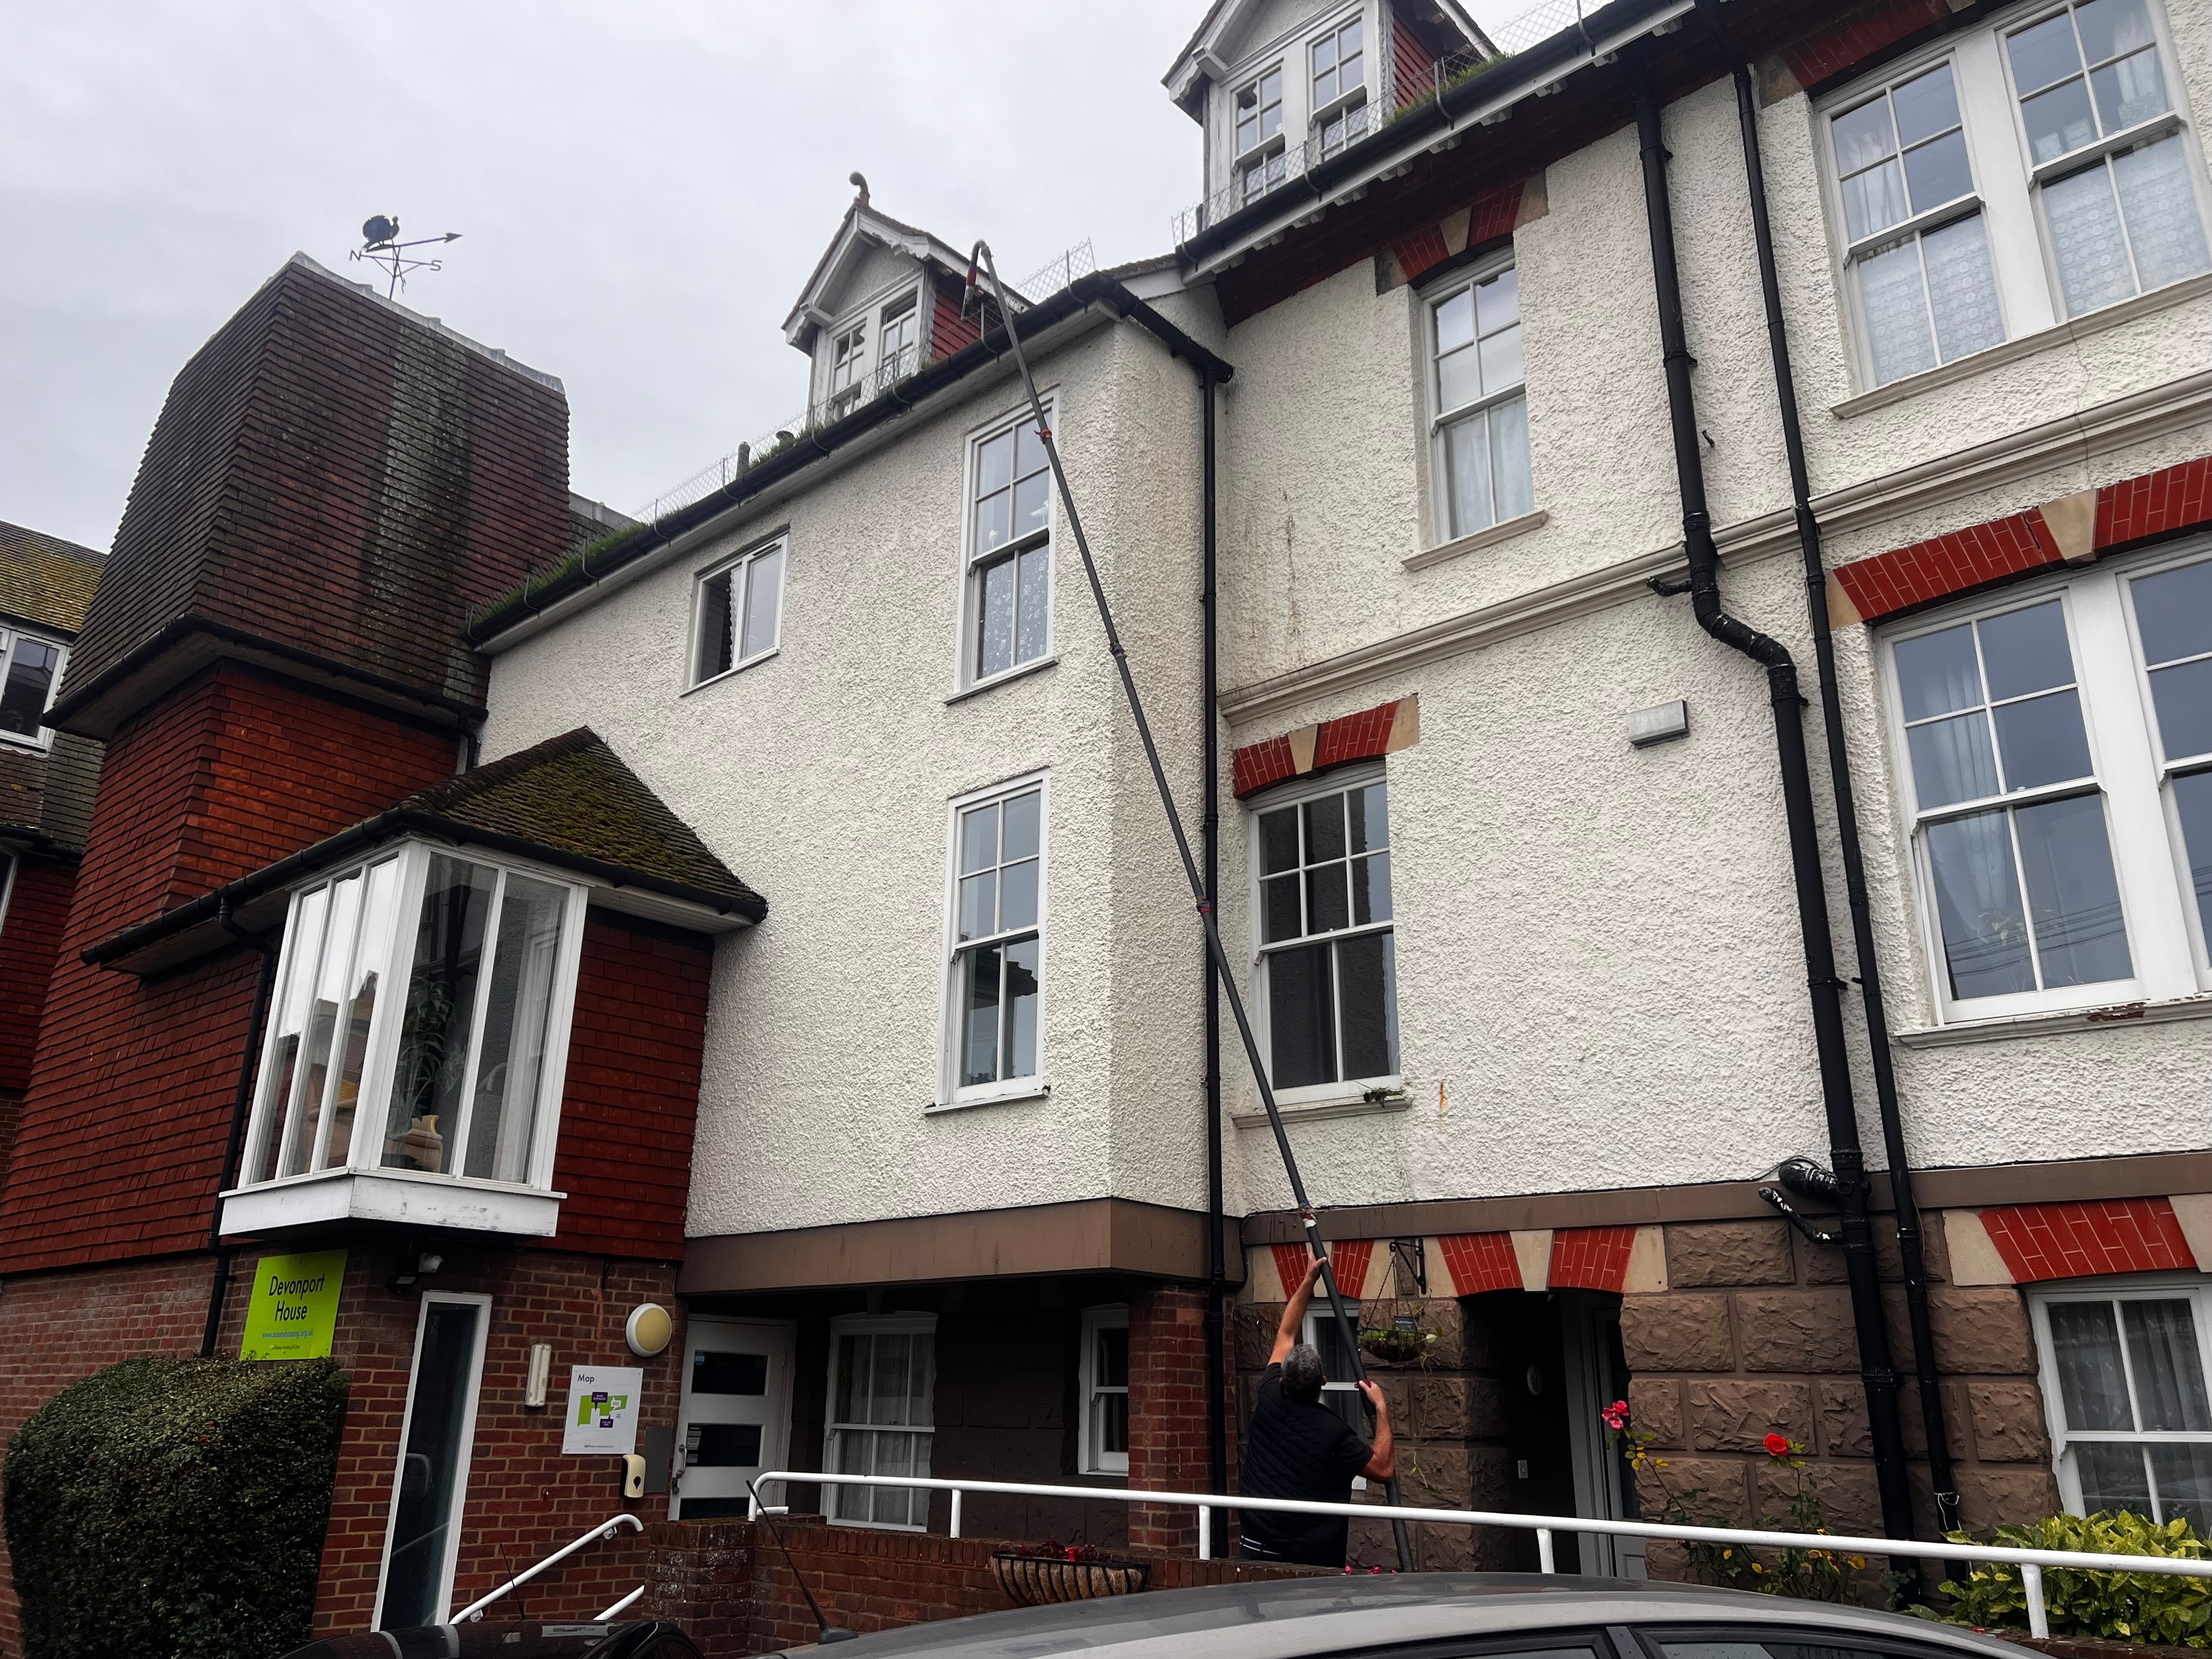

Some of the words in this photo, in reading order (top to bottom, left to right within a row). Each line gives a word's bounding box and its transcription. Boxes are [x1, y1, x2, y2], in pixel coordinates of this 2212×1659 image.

[269, 1273, 325, 1300] Devonport
[275, 1300, 308, 1321] House
[577, 1374, 594, 1384] Map
